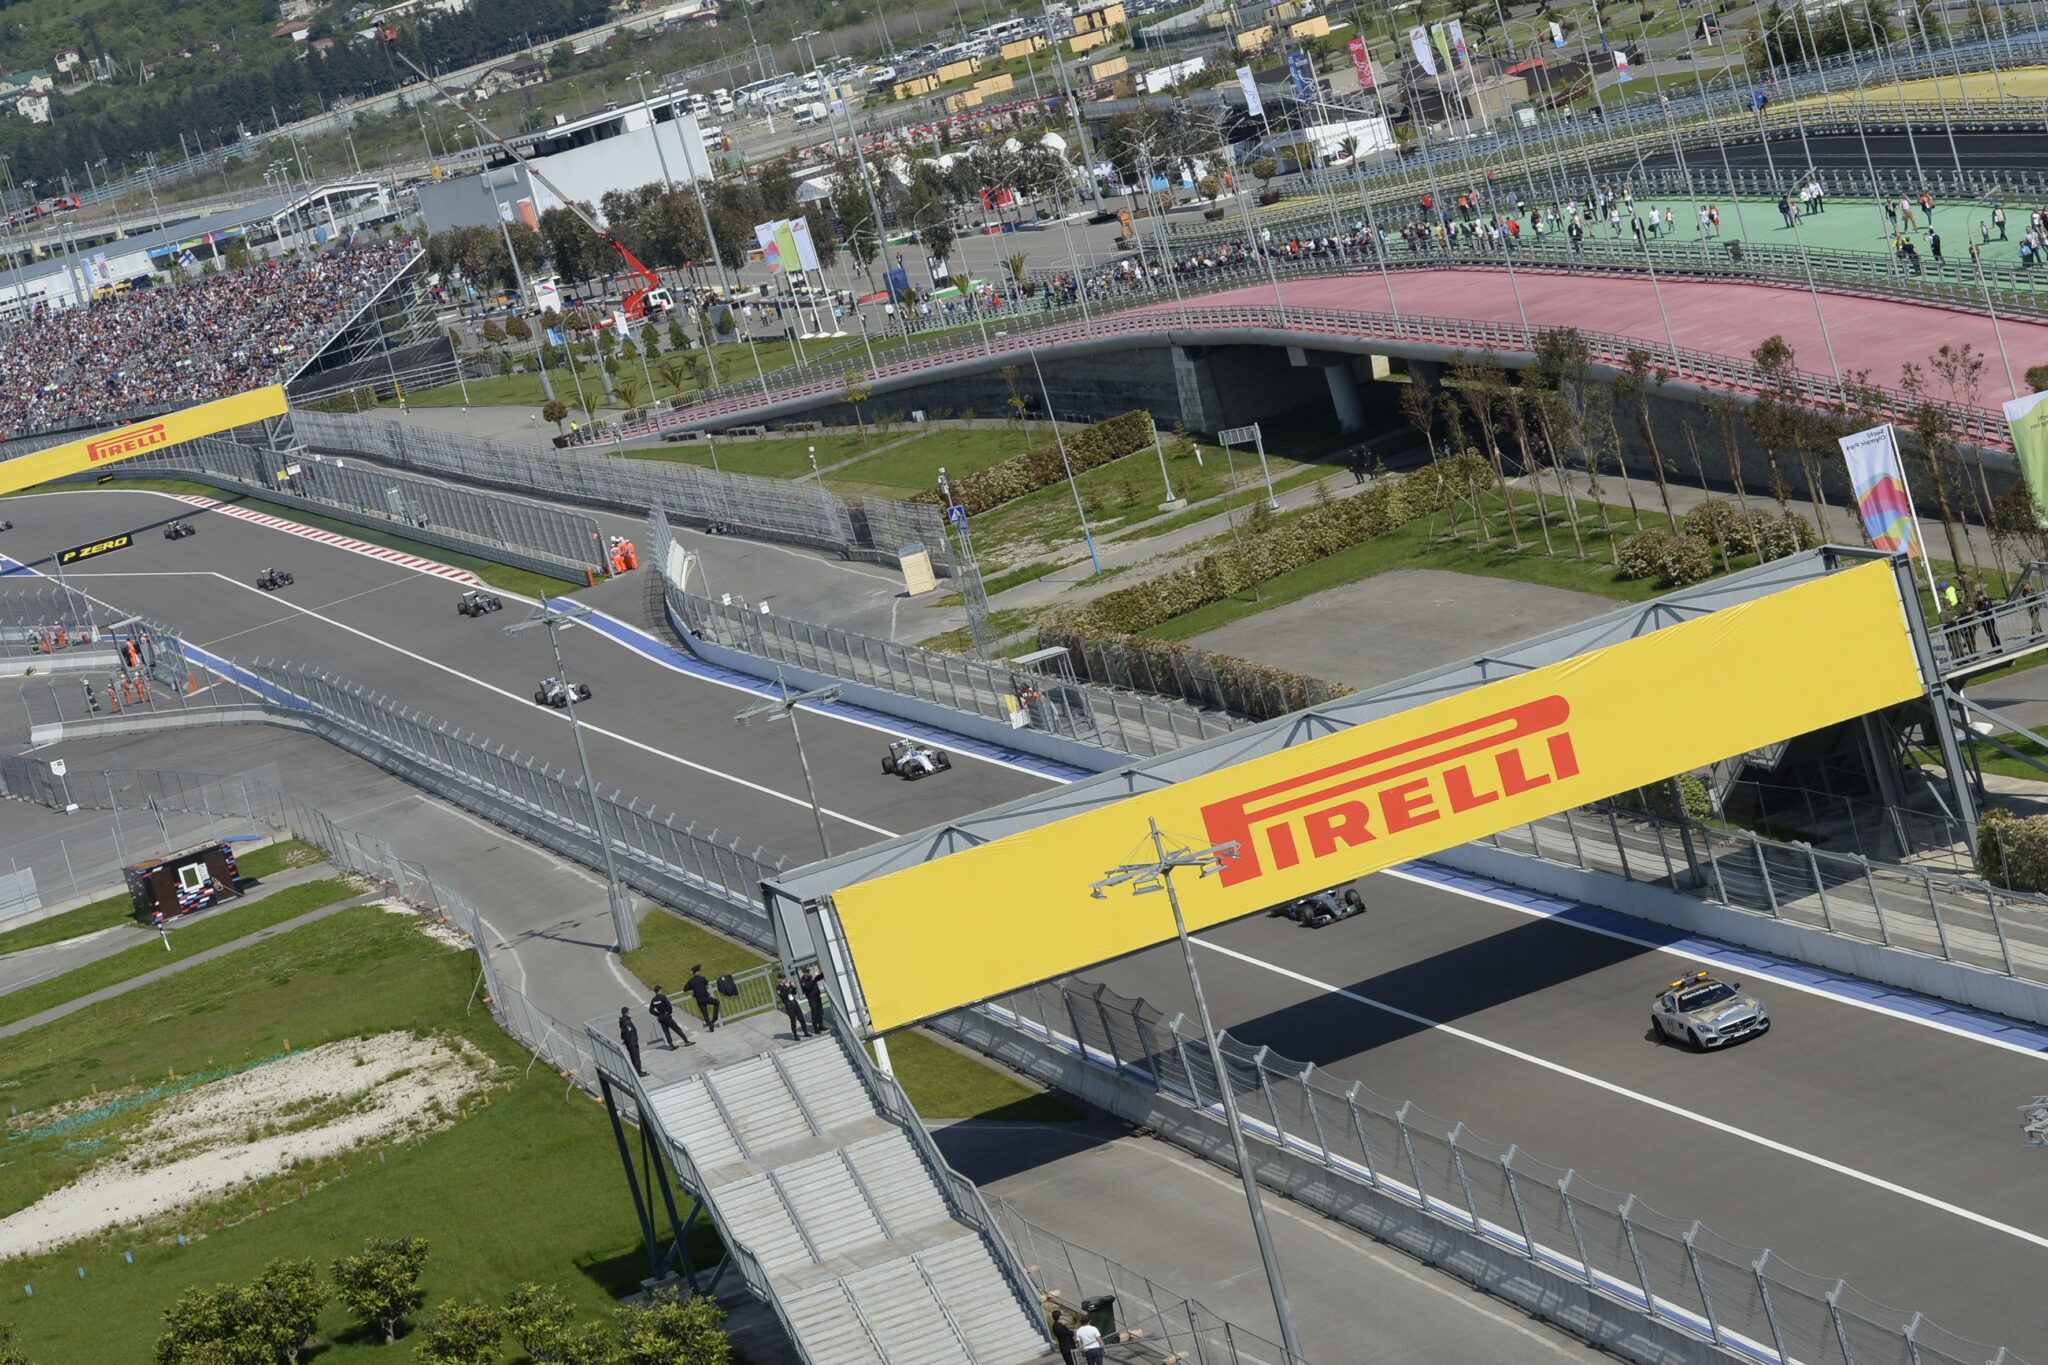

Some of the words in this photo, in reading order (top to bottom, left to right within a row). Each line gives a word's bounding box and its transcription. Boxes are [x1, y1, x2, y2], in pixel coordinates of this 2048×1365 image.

[86, 423, 167, 462] PIRELLI
[63, 551, 76, 562] P
[79, 536, 128, 558] ZERO
[1200, 695, 1580, 888] PIRELLI
